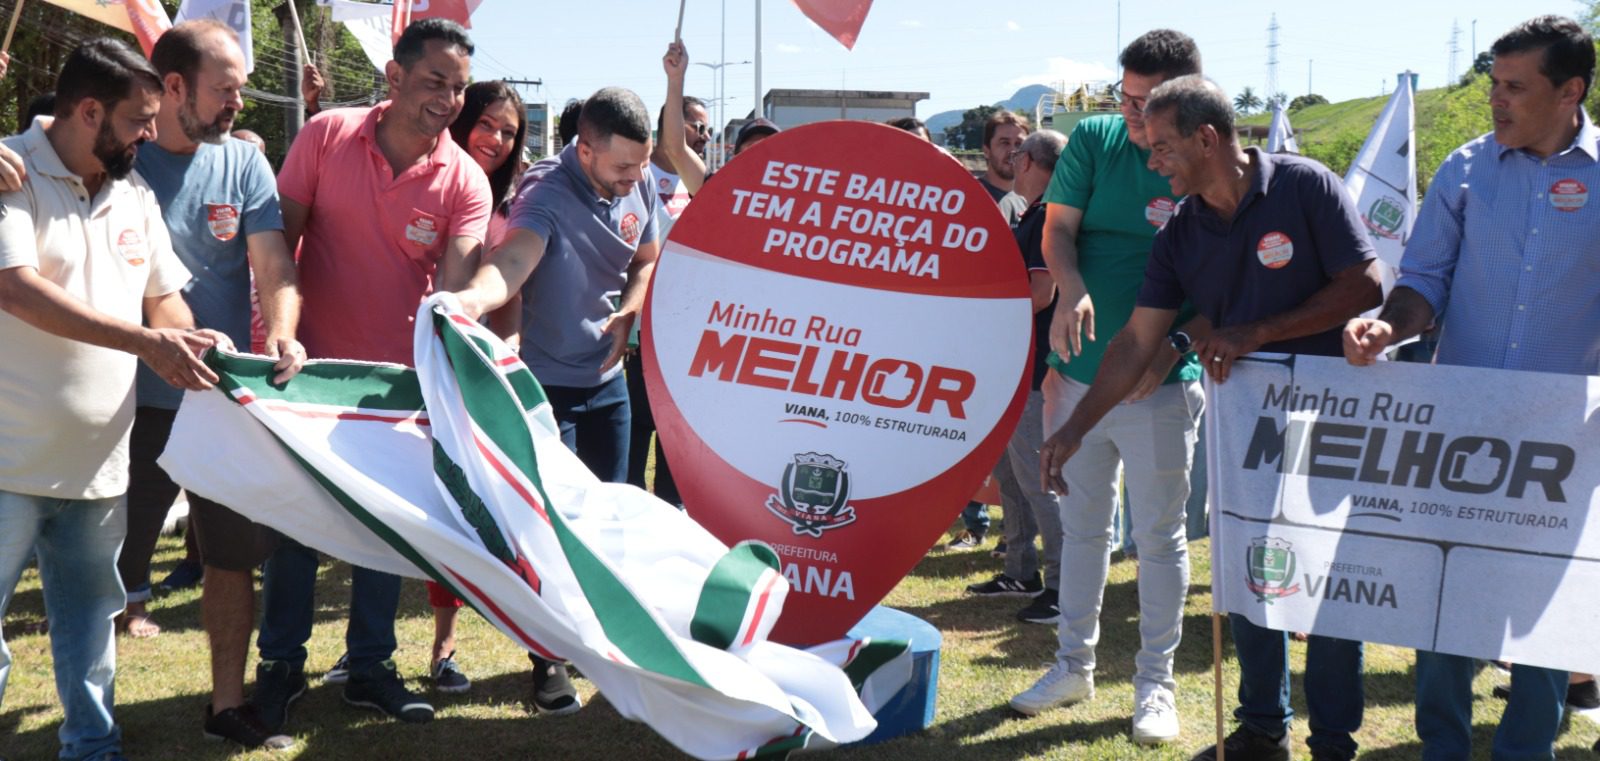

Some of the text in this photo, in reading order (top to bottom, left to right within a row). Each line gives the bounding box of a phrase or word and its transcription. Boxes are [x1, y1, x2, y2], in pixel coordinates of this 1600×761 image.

[761, 160, 966, 216] ESTE BAIRRO
[731, 189, 989, 253] TEM A FORÇA DO
[763, 228, 941, 280] PROGRAMA
[707, 300, 862, 348] Minha Rua
[688, 329, 977, 421] MELHOR
[784, 402, 967, 442] VIANA, 100% ESTRUTURADA
[1261, 383, 1436, 425] Minha Rua
[1242, 415, 1576, 503] MELHOR
[1351, 494, 1569, 529] VIANA, 100% ESTRUTURADA
[783, 563, 855, 600] ANA
[1303, 573, 1398, 609] VIANA
[1323, 561, 1383, 577] PREFEITURA
